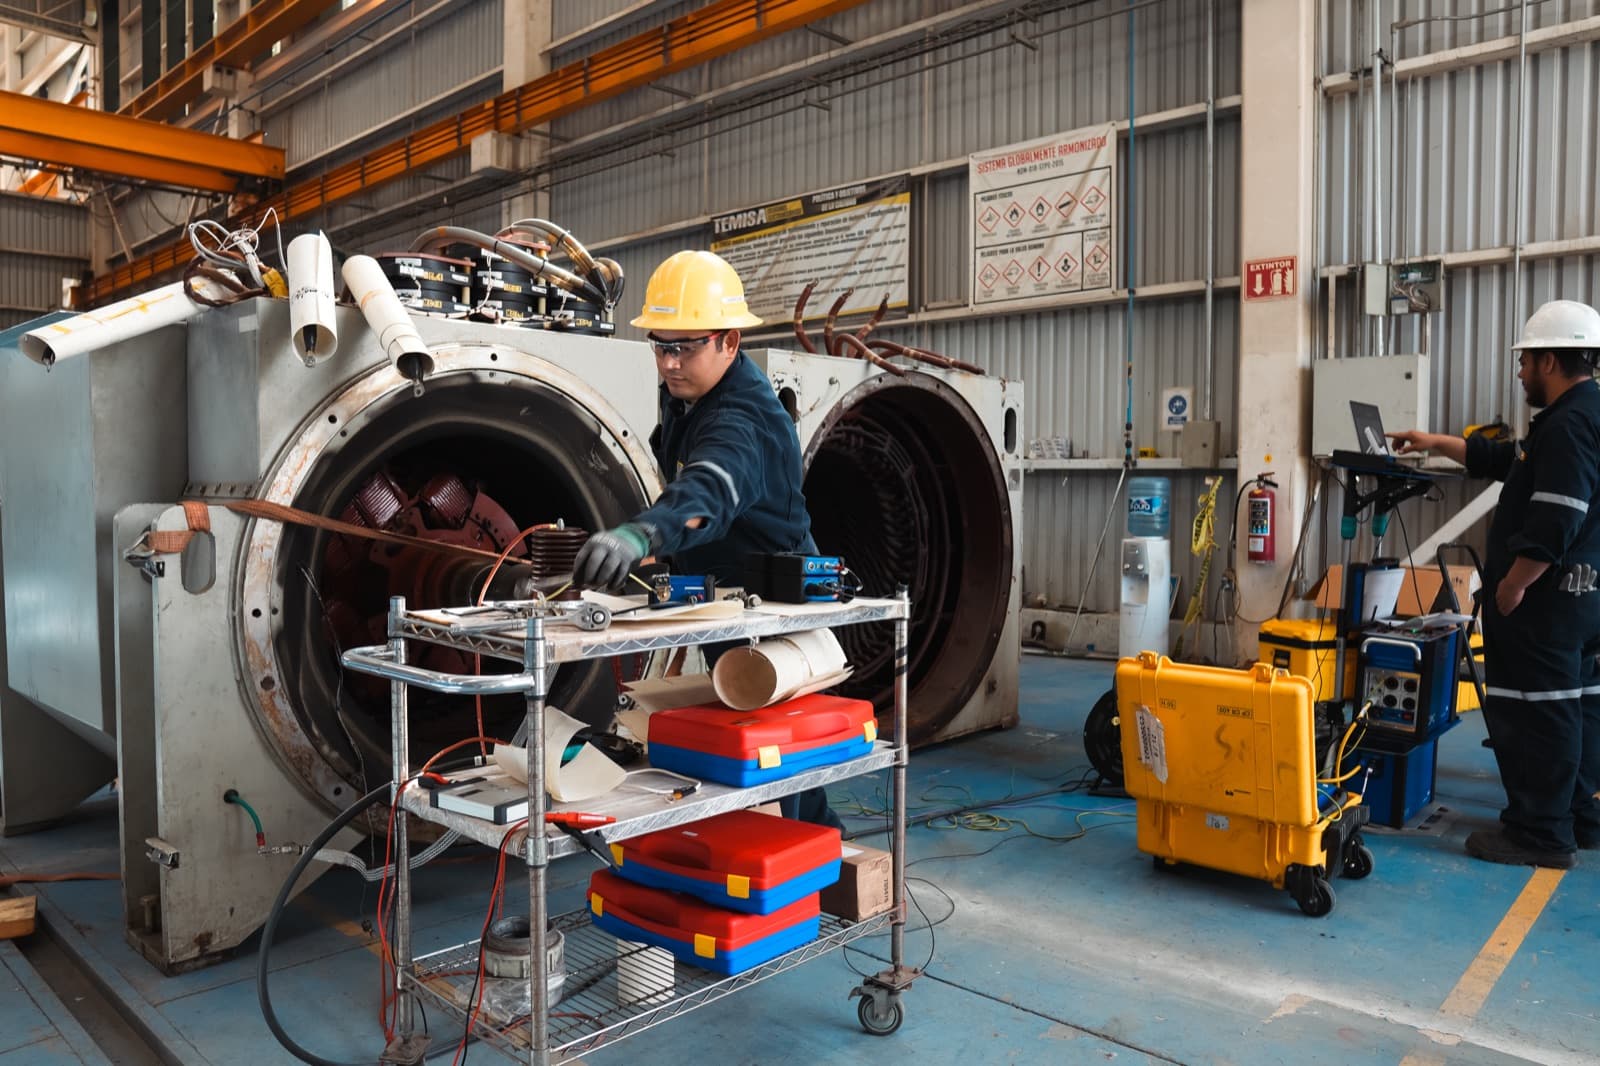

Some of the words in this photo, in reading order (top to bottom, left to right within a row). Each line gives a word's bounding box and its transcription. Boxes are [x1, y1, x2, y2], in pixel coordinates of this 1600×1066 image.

[977, 157, 1006, 174] SISTEMA
[1007, 147, 1056, 168] GLOBALMENTE
[1058, 135, 1107, 156] ARMONIZADO
[713, 208, 767, 233] TEMISA
[1250, 260, 1291, 272] EXTINTOR
